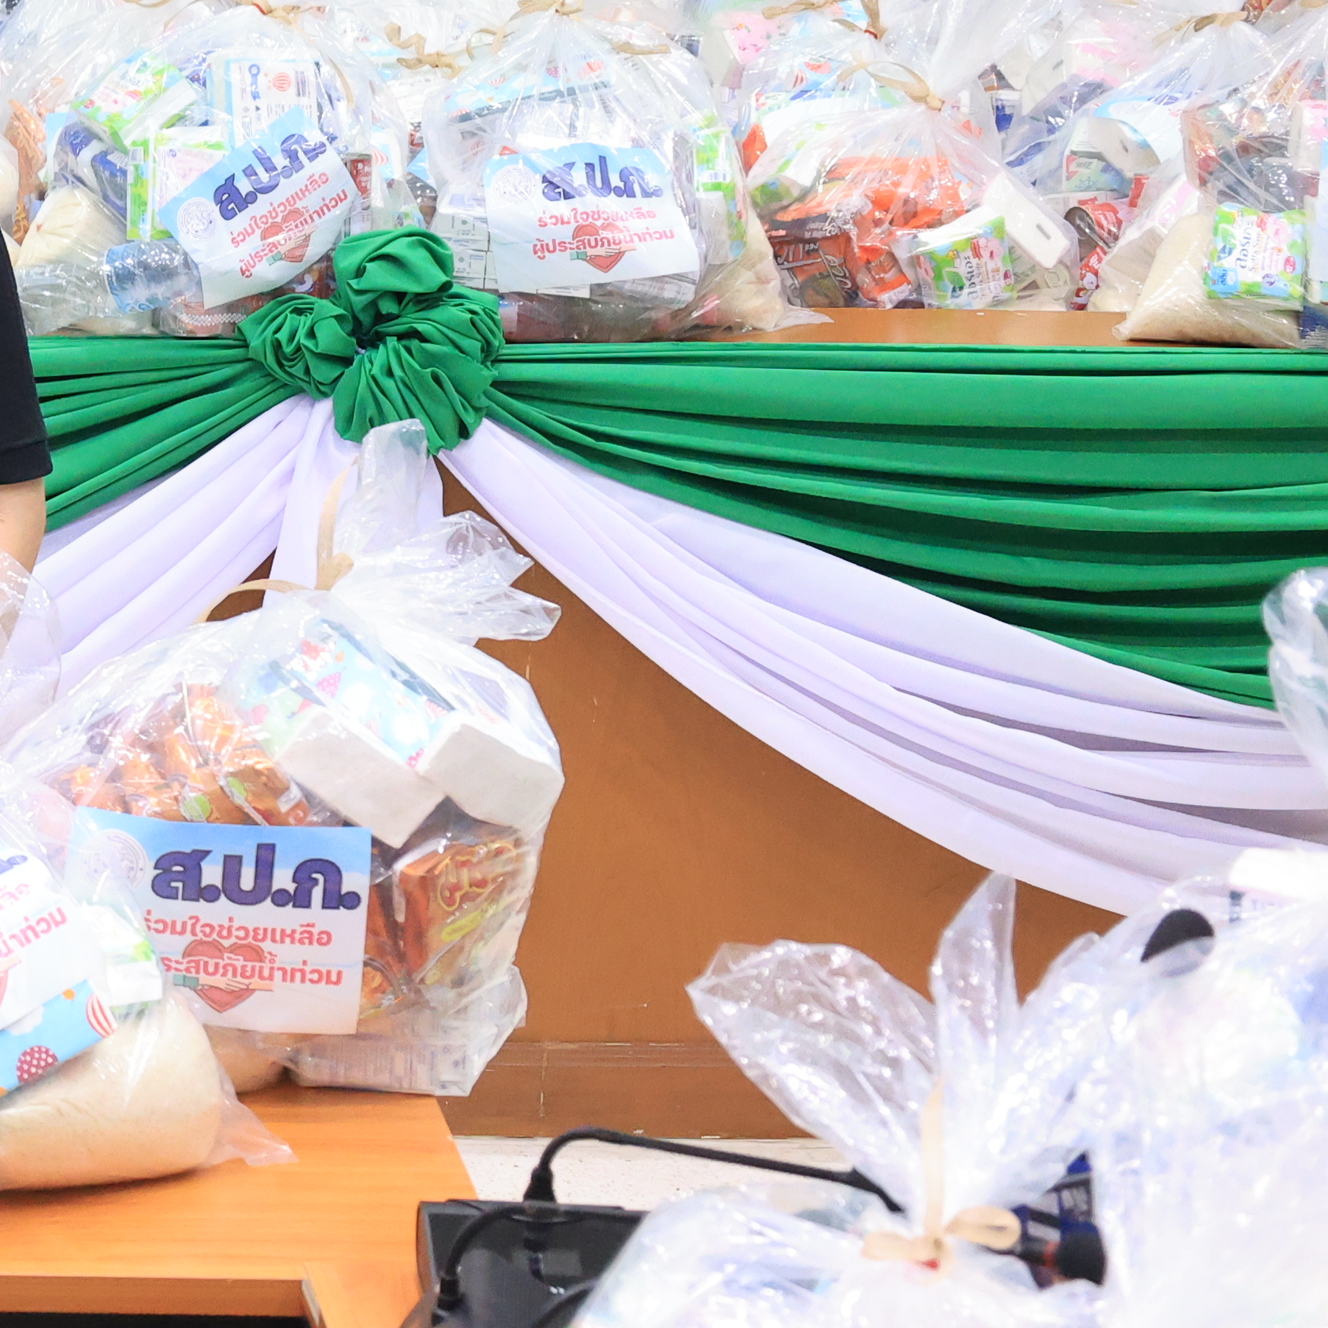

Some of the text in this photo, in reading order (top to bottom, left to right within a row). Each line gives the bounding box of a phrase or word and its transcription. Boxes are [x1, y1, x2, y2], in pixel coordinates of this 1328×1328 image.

[214, 132, 328, 222] ส.ป.ก.
[540, 158, 663, 203] ส.ป.ก.
[151, 842, 362, 911] ส.ป.ก.
[160, 950, 345, 987] ระสบภัยน้ำท่วม
